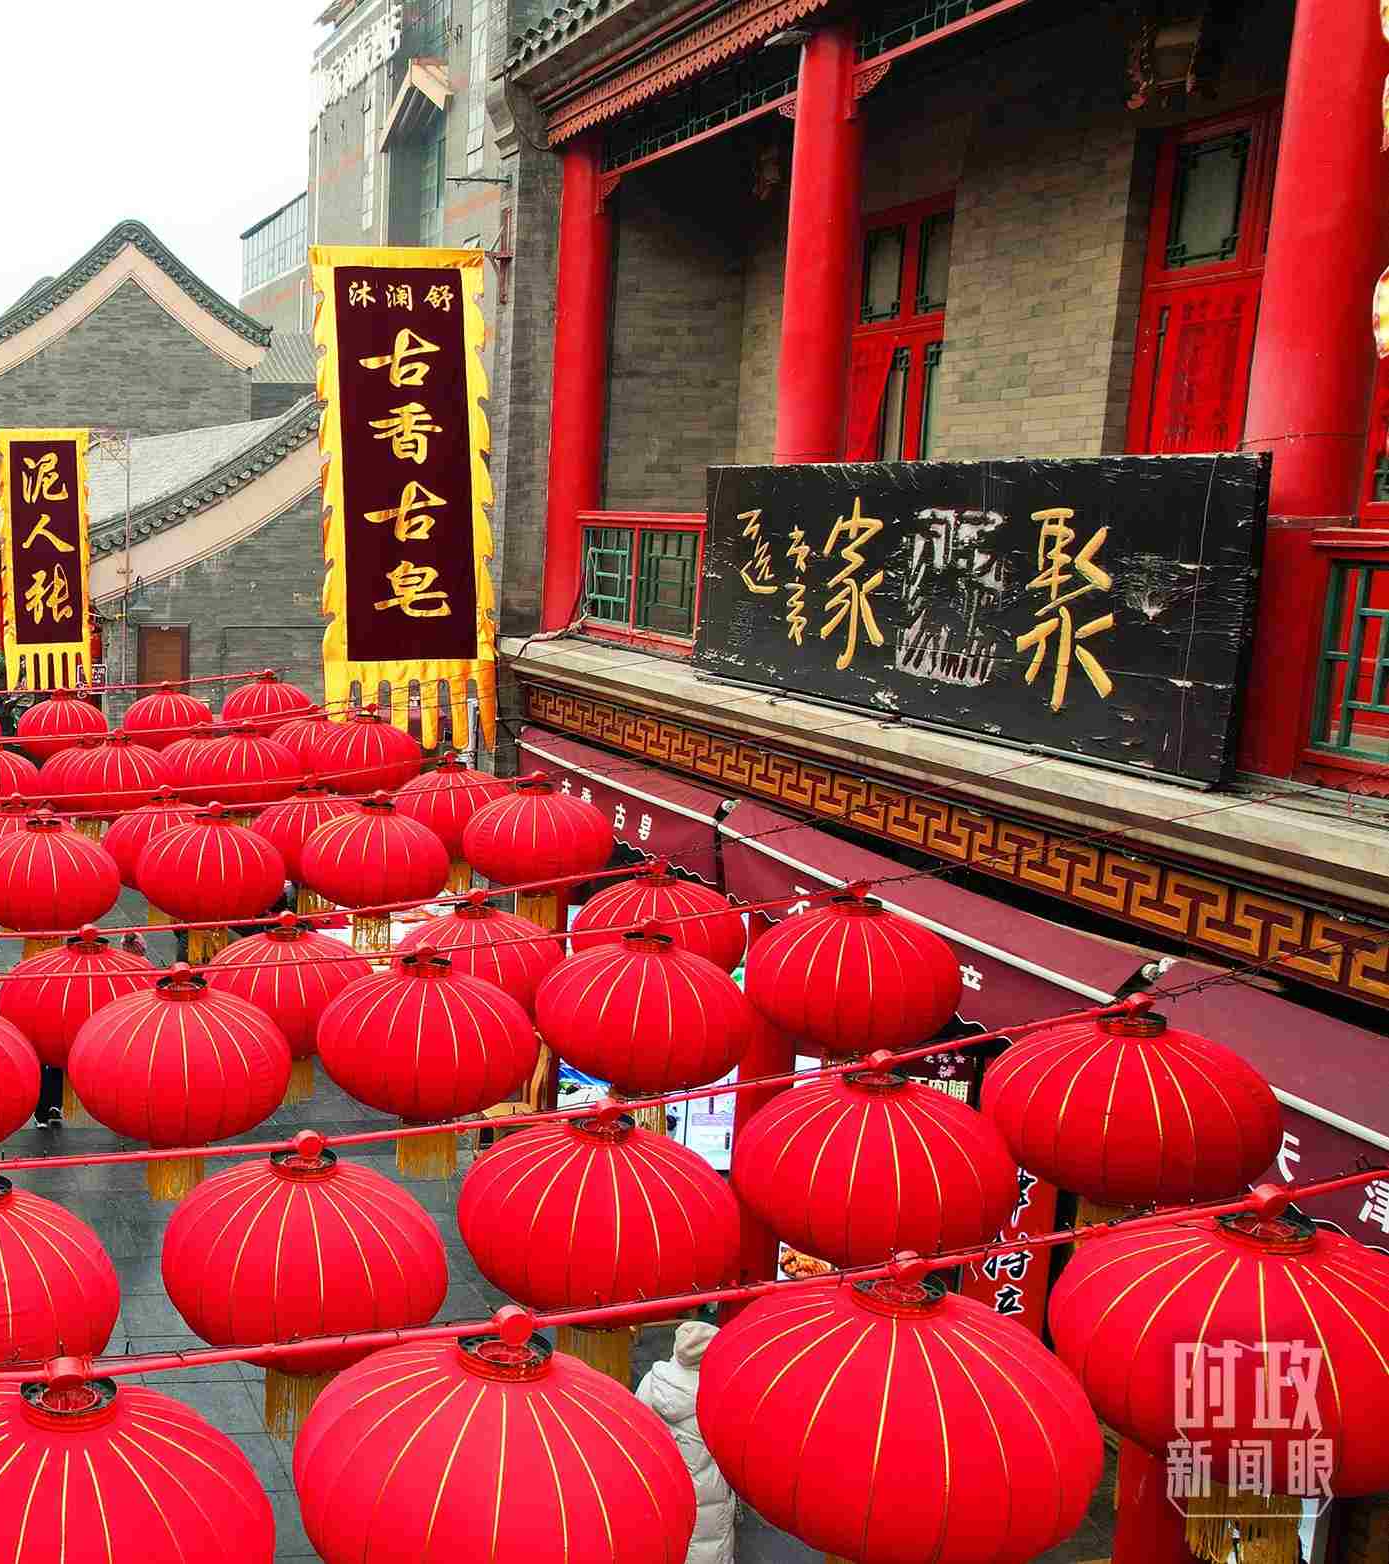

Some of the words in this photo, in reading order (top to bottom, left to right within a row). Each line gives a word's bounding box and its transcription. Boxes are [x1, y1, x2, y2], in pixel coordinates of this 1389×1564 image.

[348, 280, 454, 312] 沐澜舒
[358, 327, 452, 618] 古香古皂
